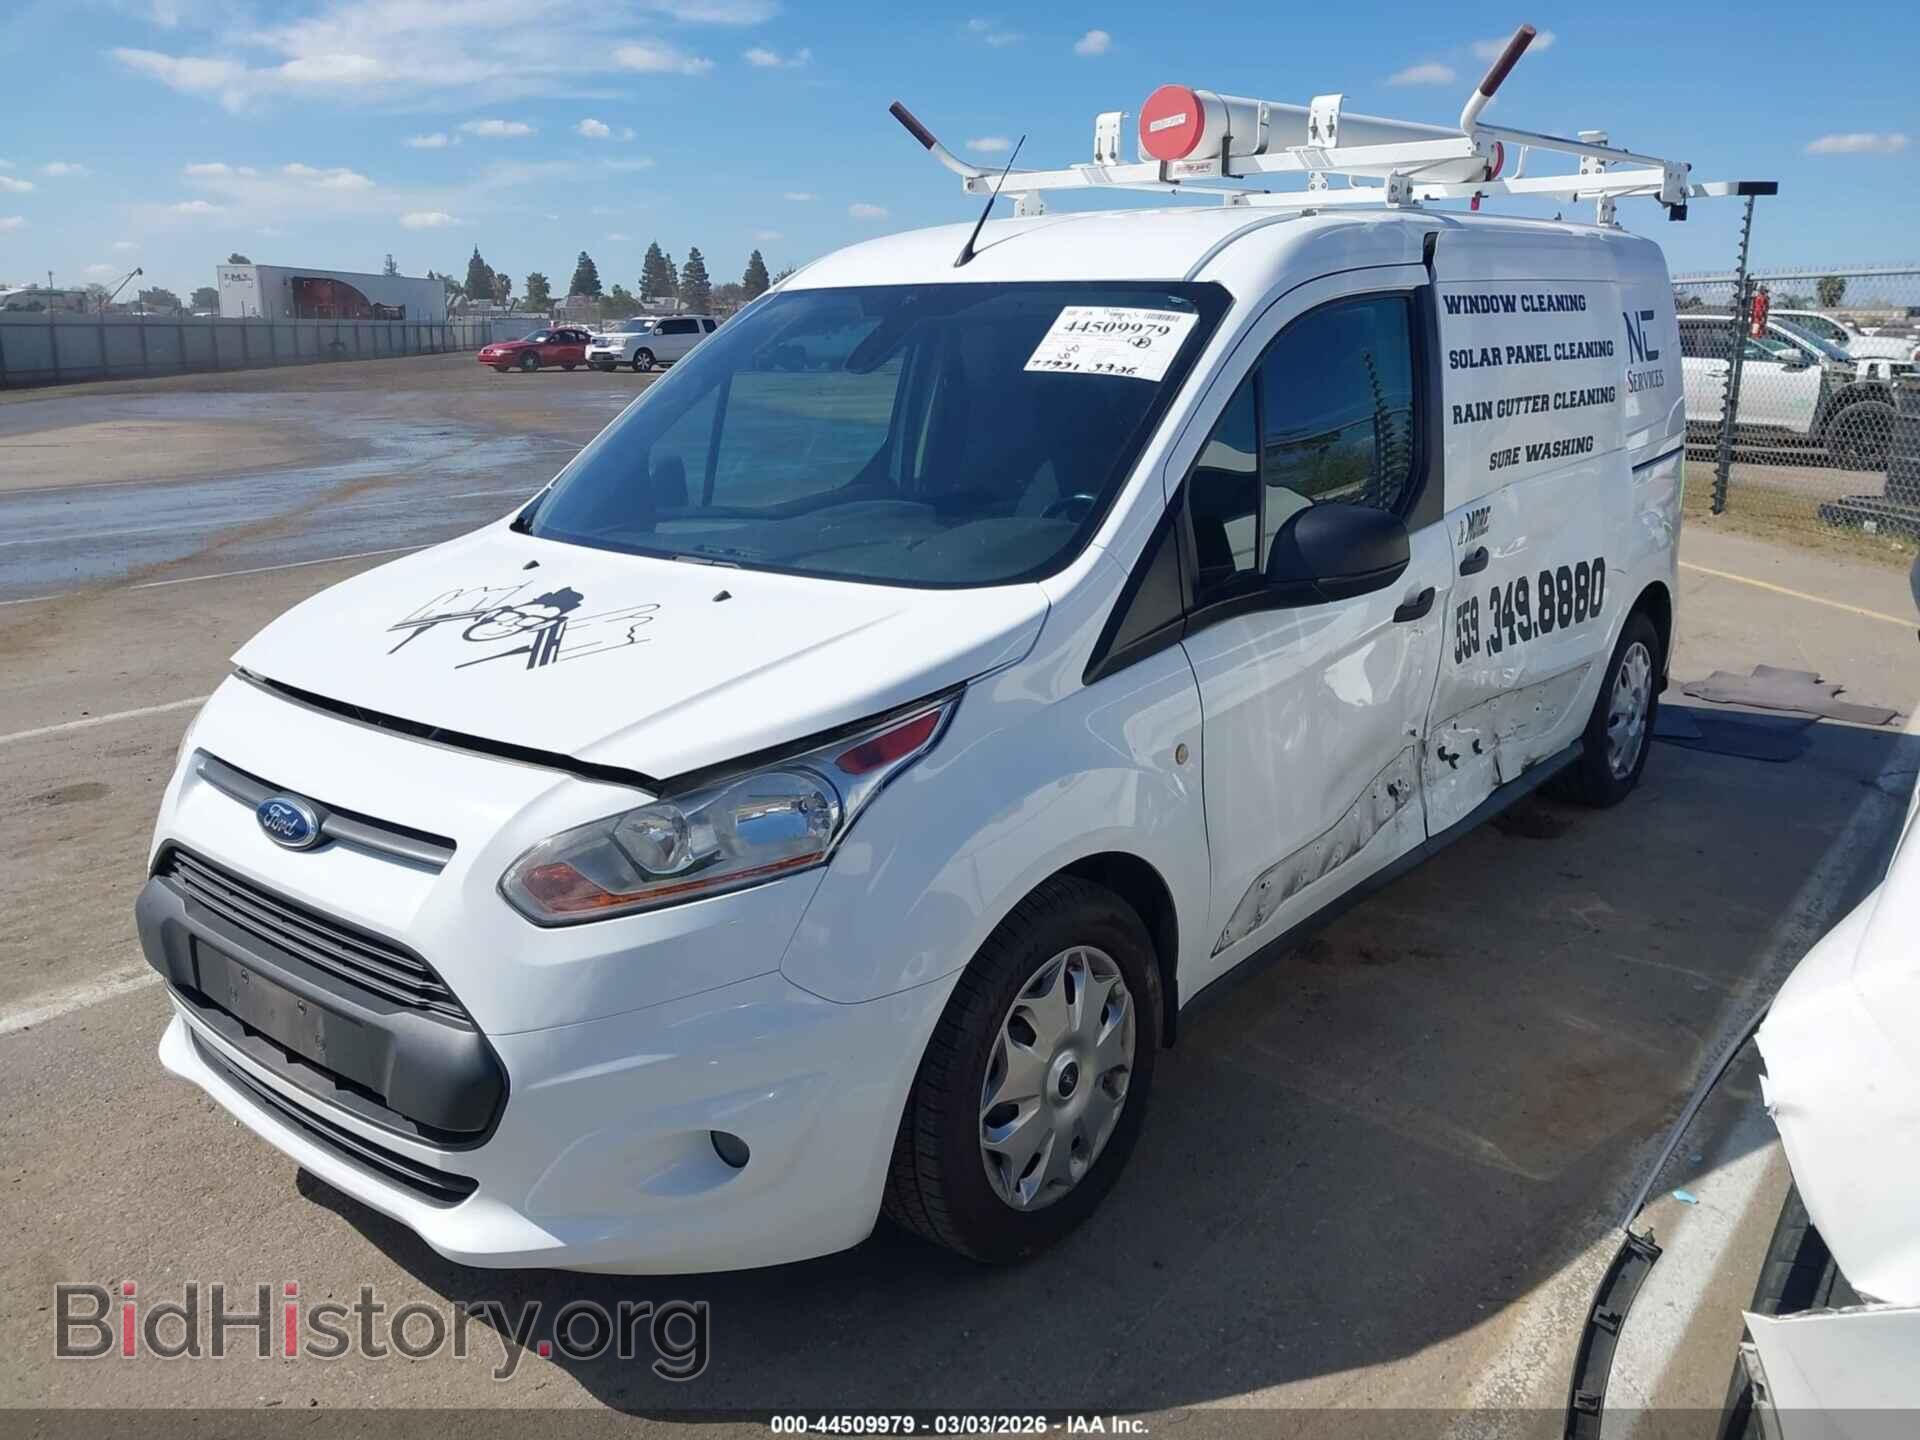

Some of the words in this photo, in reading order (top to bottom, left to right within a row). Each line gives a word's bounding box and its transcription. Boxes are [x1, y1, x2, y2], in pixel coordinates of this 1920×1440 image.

[1443, 294, 1517, 314] WINDOW
[1521, 294, 1587, 313] CLEANING
[1064, 319, 1171, 338] 44509979
[1449, 346, 1503, 370] SOLAR
[1506, 344, 1551, 365] PANEL
[1554, 340, 1614, 361] CLEANING
[1452, 401, 1493, 425] RAIN
[1496, 395, 1550, 418] GUTTER
[1553, 386, 1616, 411] CLEANING
[1489, 447, 1520, 471] SURE
[1525, 435, 1594, 463] WASHING
[263, 803, 299, 836] Ford
